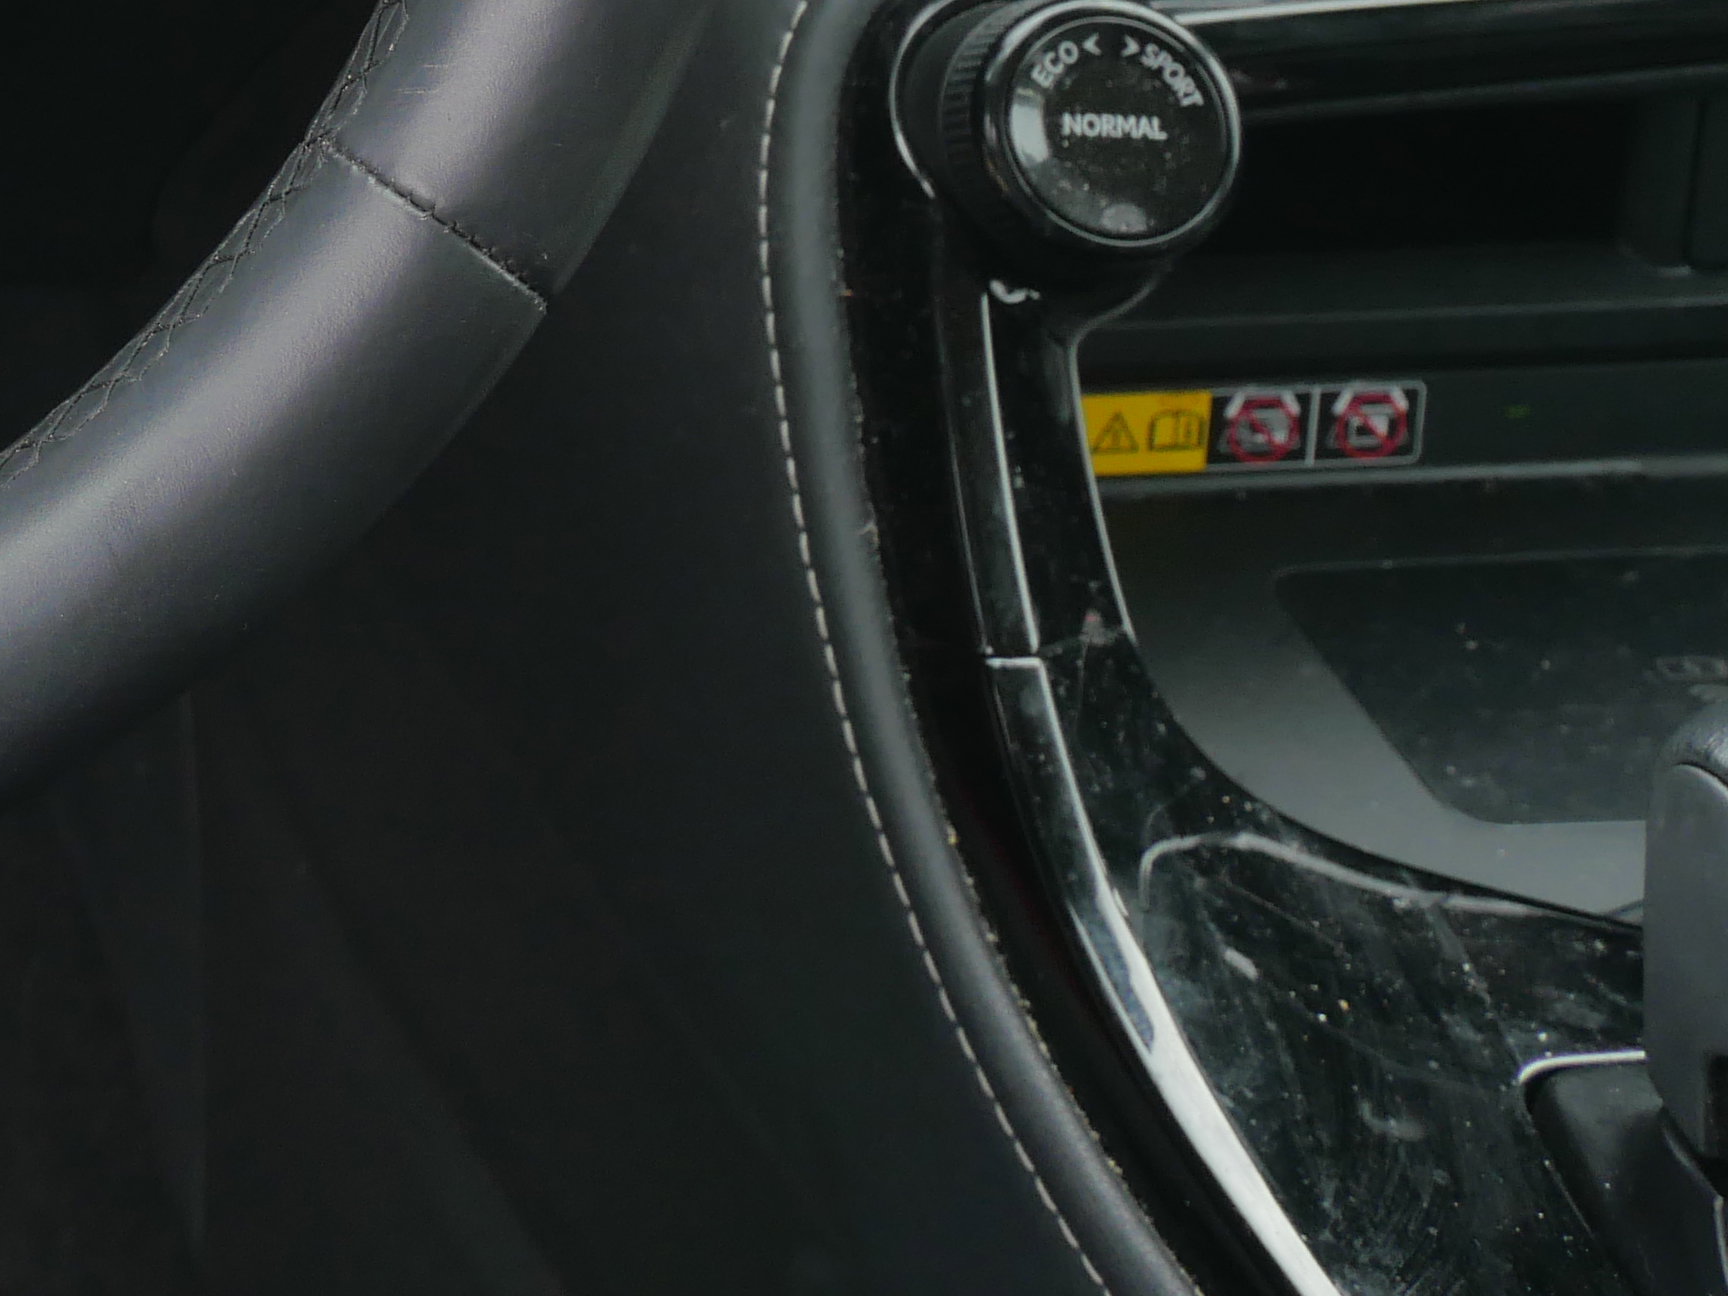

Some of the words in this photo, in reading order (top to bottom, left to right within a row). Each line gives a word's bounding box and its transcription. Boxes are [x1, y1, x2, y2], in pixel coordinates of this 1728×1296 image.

[1030, 40, 1080, 89] ECO
[1139, 42, 1205, 107] SPORT
[1061, 111, 1168, 141] NORMAL
